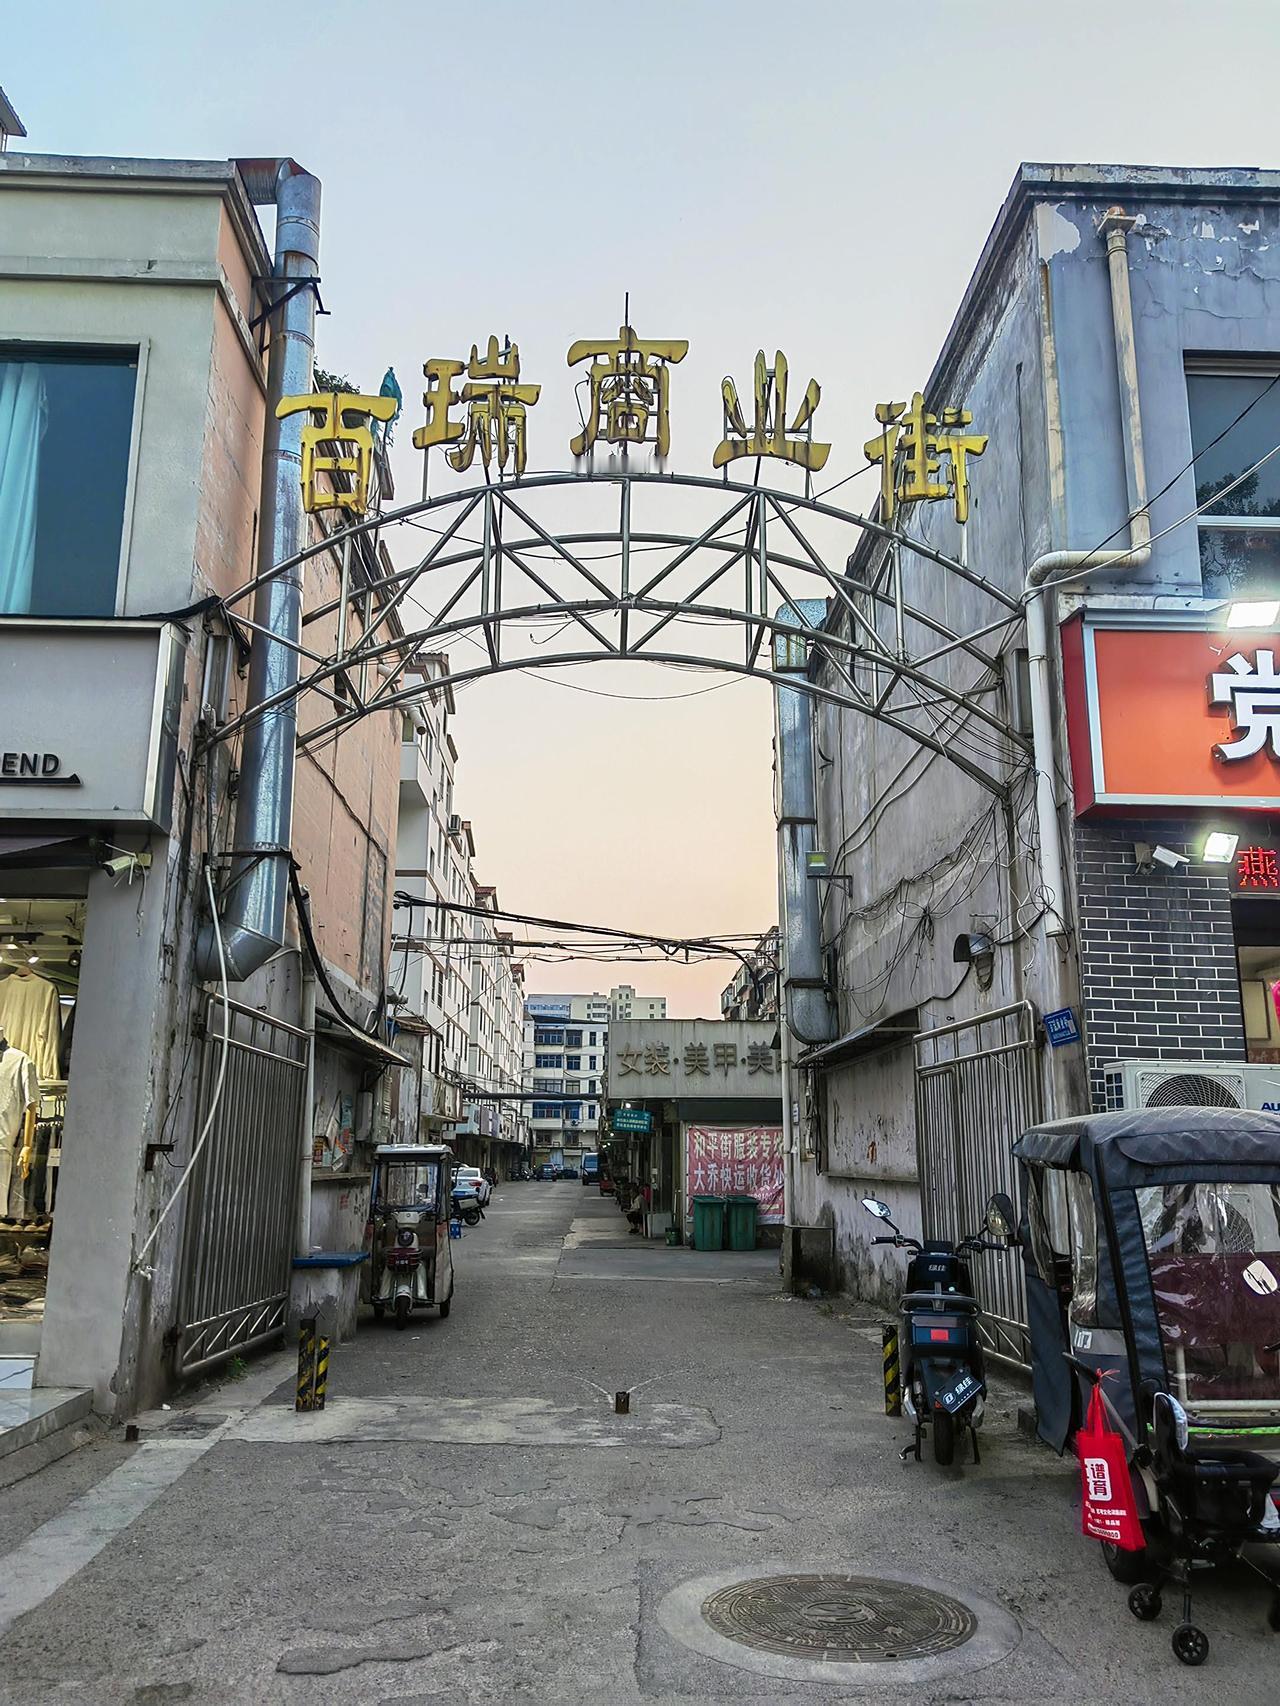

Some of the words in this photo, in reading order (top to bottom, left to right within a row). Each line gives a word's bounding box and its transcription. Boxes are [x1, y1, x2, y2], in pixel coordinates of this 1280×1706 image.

[275, 326, 989, 525] 百瑞商业街
[1236, 846, 1279, 887] 燕
[617, 1040, 782, 1077] 女装·美甲·美
